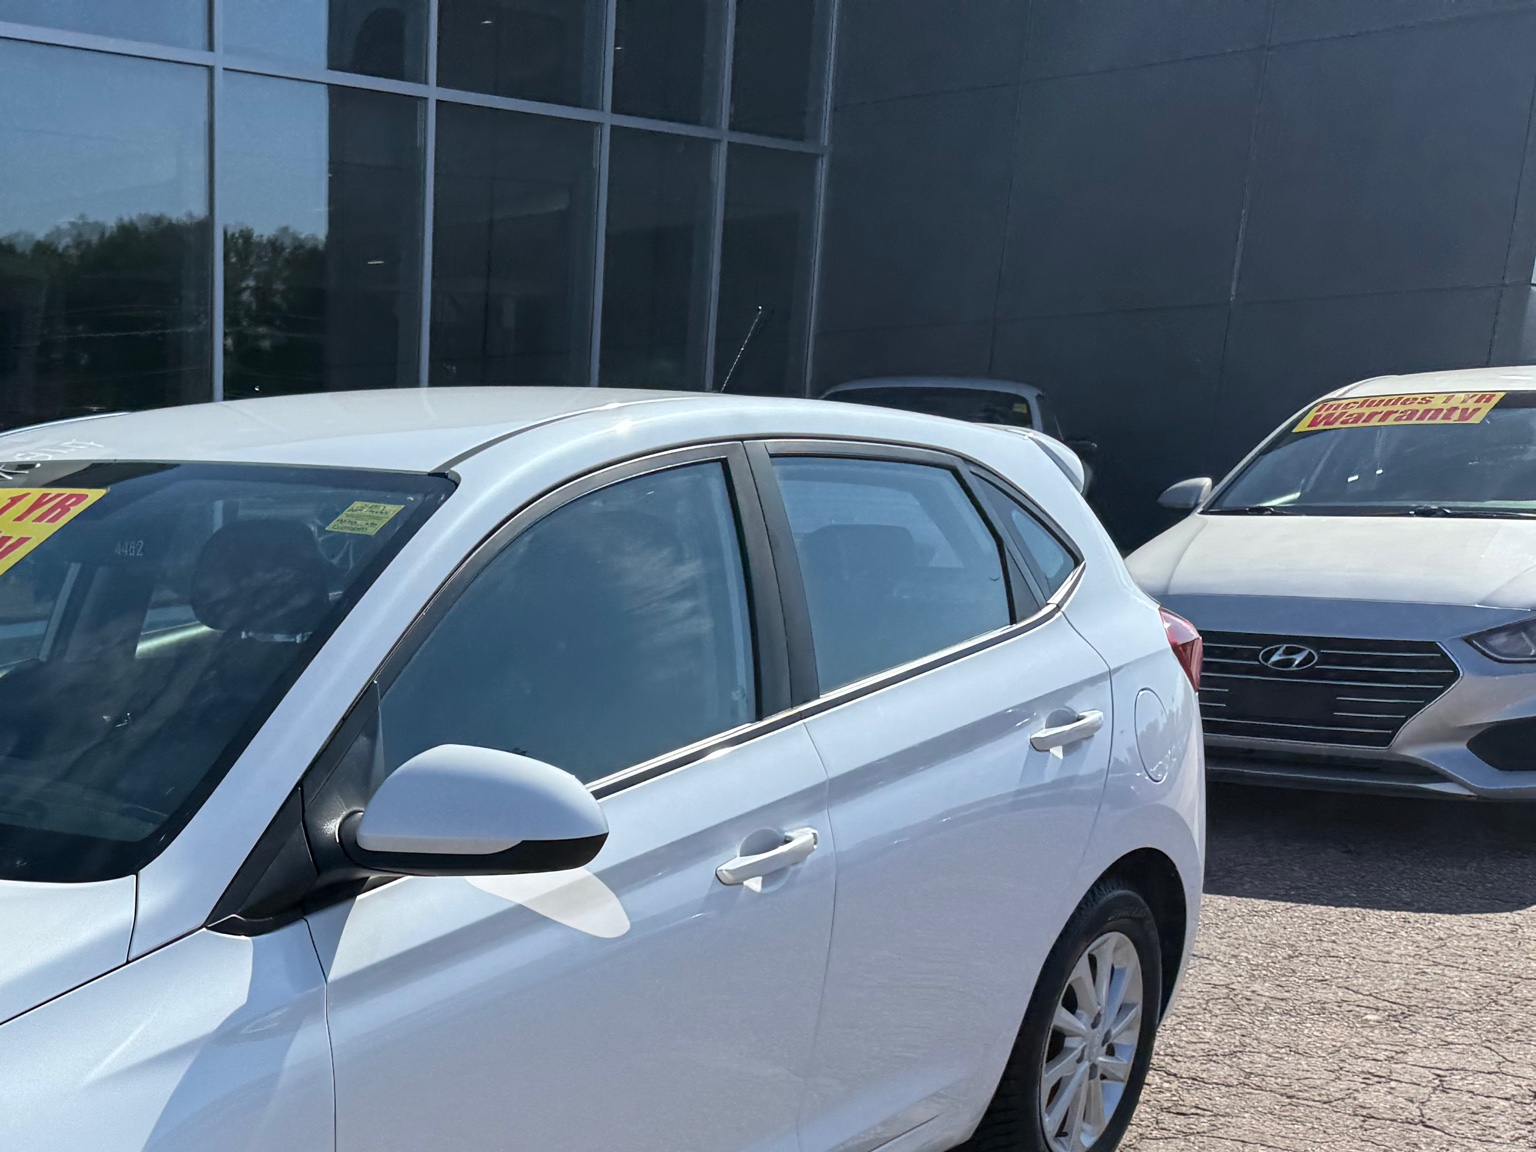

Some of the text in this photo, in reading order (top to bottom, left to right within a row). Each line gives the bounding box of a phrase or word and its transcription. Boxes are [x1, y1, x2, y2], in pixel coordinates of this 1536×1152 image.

[1315, 394, 1497, 413] Includes 1 YR
[1307, 407, 1481, 428] Warranty
[13, 492, 90, 524] YR
